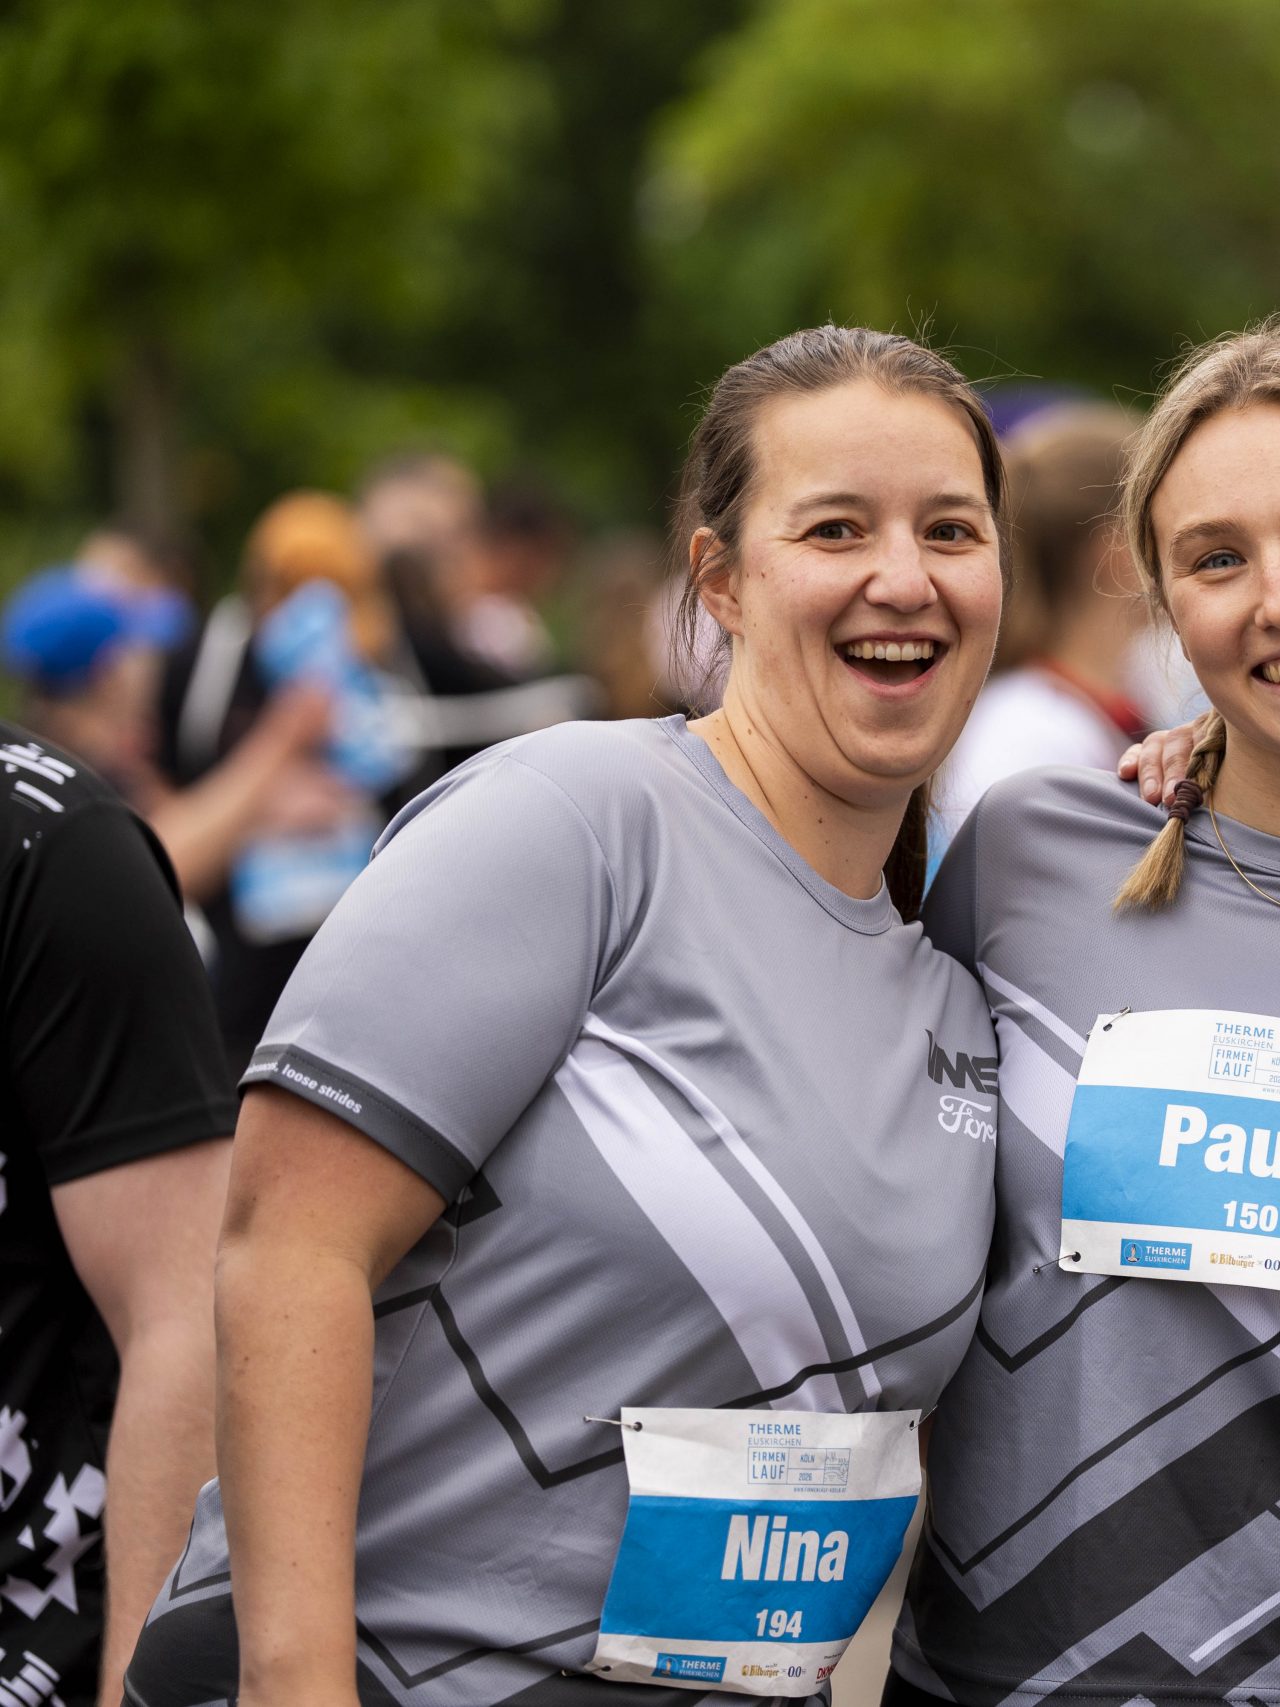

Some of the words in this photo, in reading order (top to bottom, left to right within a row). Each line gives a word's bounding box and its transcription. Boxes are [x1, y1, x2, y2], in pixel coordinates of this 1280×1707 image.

[1215, 1022, 1275, 1040] THERME
[1213, 1035, 1274, 1050] EUSKIRCHEN
[1216, 1048, 1254, 1062] FIRMEN
[1213, 1060, 1252, 1078] LAUF
[281, 1063, 318, 1090] loose
[318, 1084, 362, 1114] strides
[1223, 1200, 1279, 1233] 150
[1145, 1245, 1187, 1257] THERME
[1144, 1255, 1187, 1265] EUSKIRCHEN
[1218, 1253, 1255, 1269] Bitburger
[748, 1423, 801, 1435] THERME
[748, 1437, 801, 1446] EUSKIRCHEN
[752, 1451, 786, 1462] FIRMEN
[752, 1464, 785, 1480] LAUF
[720, 1514, 849, 1583] Nina
[755, 1608, 803, 1639] 194
[681, 1659, 722, 1671] THERME
